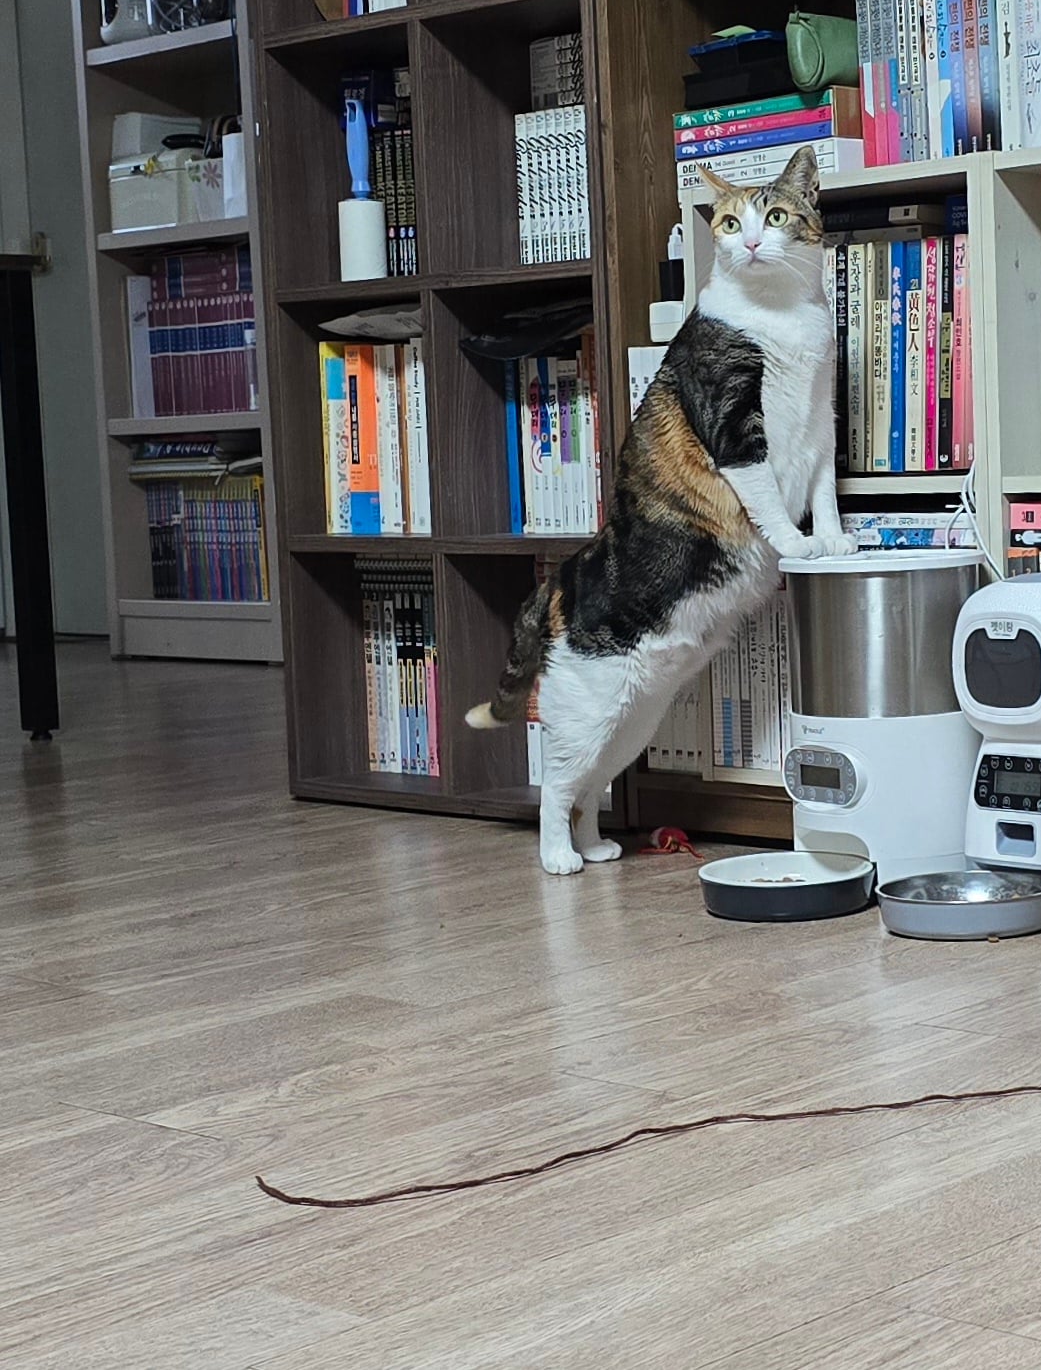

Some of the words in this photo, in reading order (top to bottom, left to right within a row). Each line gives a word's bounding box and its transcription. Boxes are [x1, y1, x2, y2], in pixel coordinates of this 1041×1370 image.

[386, 180, 397, 226] KEATON
[397, 179, 407, 226] KEATON
[406, 179, 416, 226] KEATON
[850, 250, 861, 297] 훈장과
[850, 301, 861, 330] 굴레
